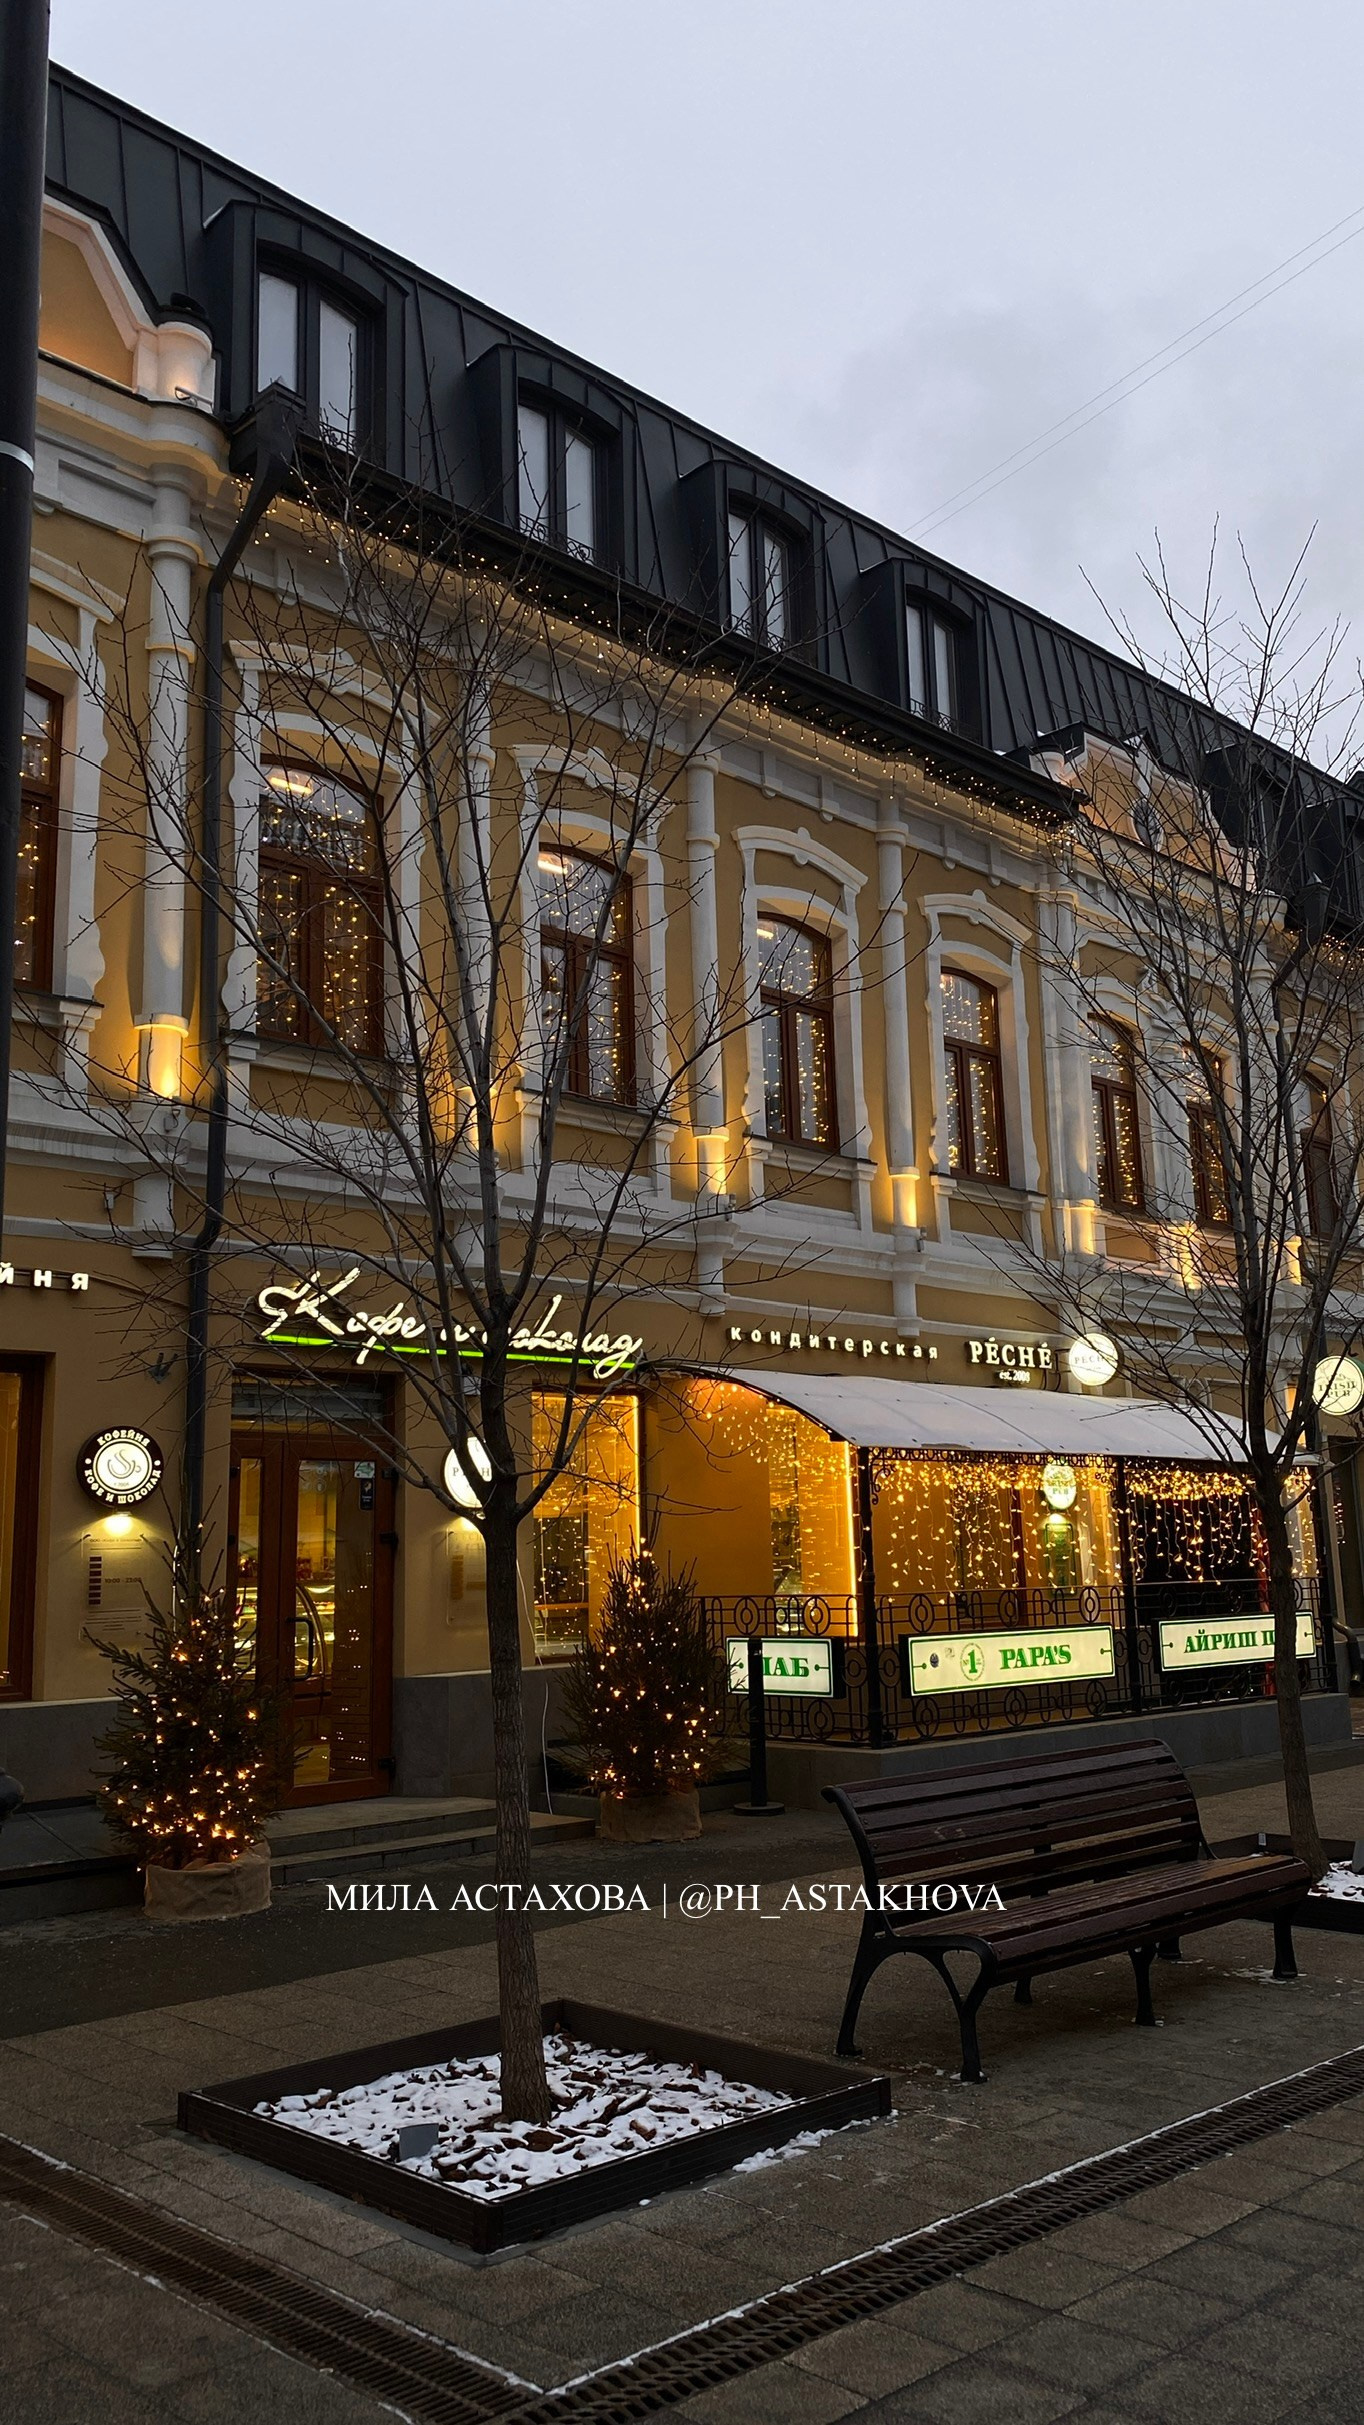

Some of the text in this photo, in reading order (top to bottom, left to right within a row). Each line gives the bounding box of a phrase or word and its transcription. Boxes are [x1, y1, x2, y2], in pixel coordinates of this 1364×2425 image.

[258, 1267, 426, 1366] Кофе
[731, 1327, 938, 1359] кондитерская
[969, 1337, 1053, 1369] PÉCHÉ
[97, 1429, 150, 1447] КОФЕЙНЯ
[84, 1469, 161, 1504] КОФЕ И ШОКОЛАД
[1000, 1644, 1072, 1669] PAPA'S
[1184, 1629, 1257, 1653] АЙРИШ
